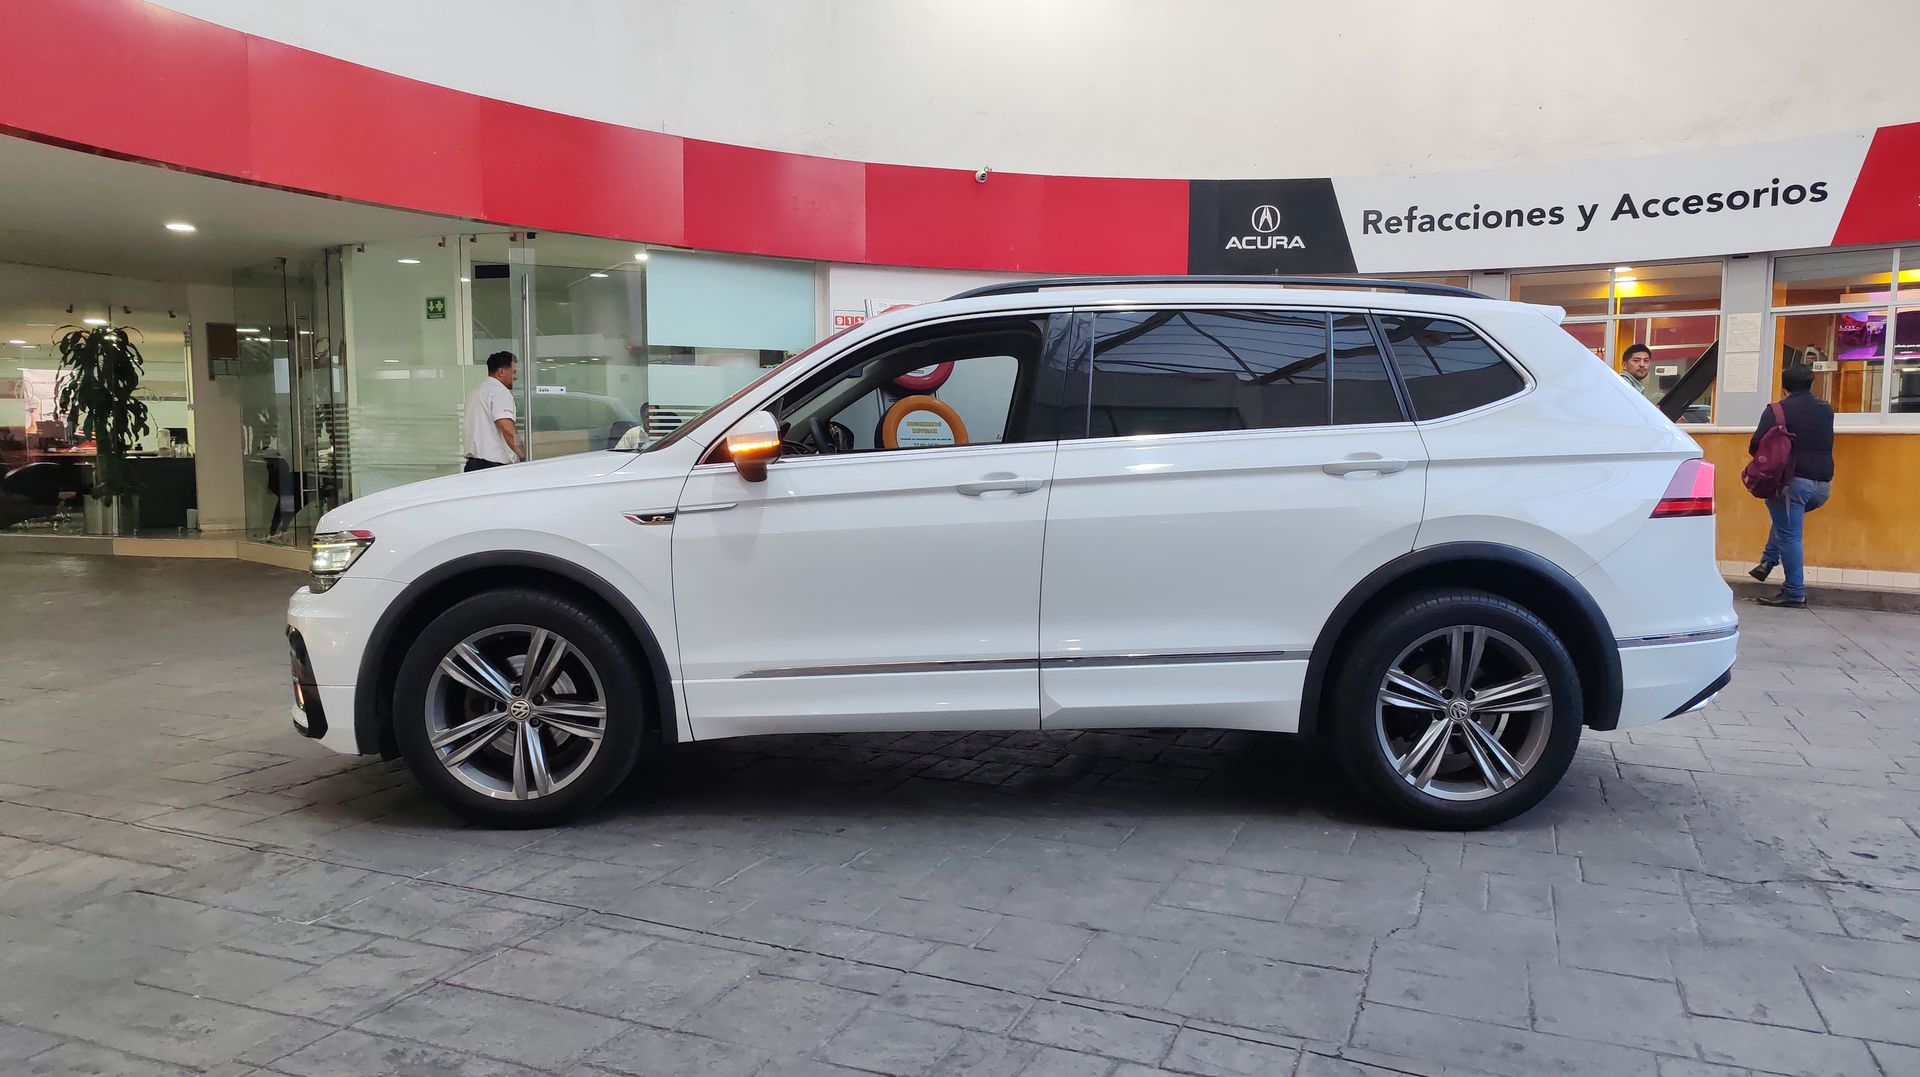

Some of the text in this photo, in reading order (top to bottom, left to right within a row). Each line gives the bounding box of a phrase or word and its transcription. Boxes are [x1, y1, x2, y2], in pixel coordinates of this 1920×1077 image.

[1362, 177, 1829, 235] Refacciones y Accesorios
[1224, 235, 1306, 250] ACURA
